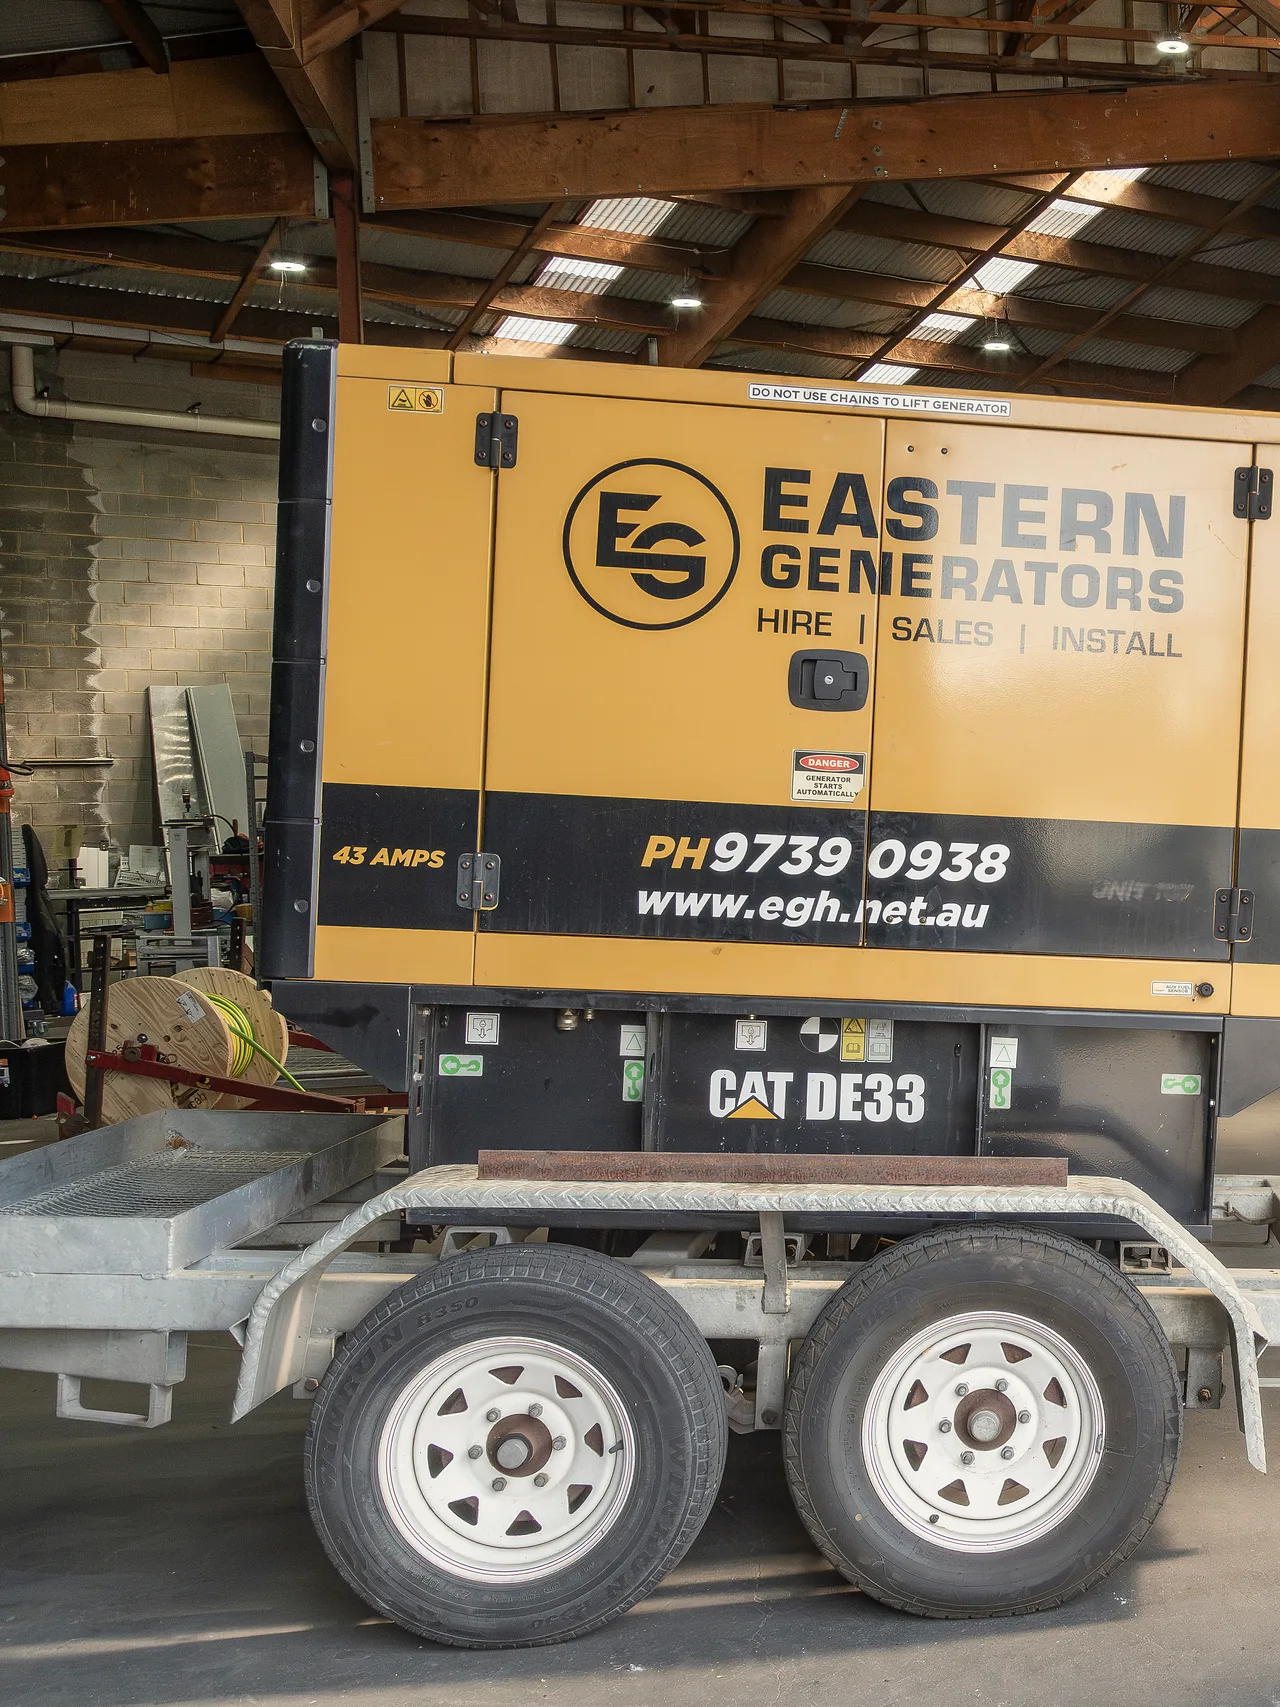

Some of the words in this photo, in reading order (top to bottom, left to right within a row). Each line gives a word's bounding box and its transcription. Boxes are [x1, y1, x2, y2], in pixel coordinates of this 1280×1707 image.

[752, 387, 770, 397] DO
[773, 388, 800, 399] NOT
[803, 391, 827, 402] USE
[830, 393, 879, 405] CHAINS
[882, 396, 899, 407] TO
[902, 398, 929, 409] LIFT
[932, 400, 1008, 415] GENERATOR
[762, 466, 1187, 559] EASTERN
[760, 544, 1184, 614] GENERATORS
[757, 607, 833, 637] HIRE
[892, 616, 994, 647] SALES
[1053, 625, 1183, 659] INSTALL
[806, 775, 851, 783] GENERATOR
[808, 758, 851, 768] DANGER
[797, 789, 859, 797] AUTOMATICALLY
[814, 782, 843, 790] STARTS
[332, 845, 368, 865] 43
[369, 847, 446, 869] AMPS
[868, 839, 1011, 883] 0938
[637, 890, 990, 928] www.egh.net.au
[709, 1069, 794, 1120] CAT
[805, 1072, 925, 1123] DE33
